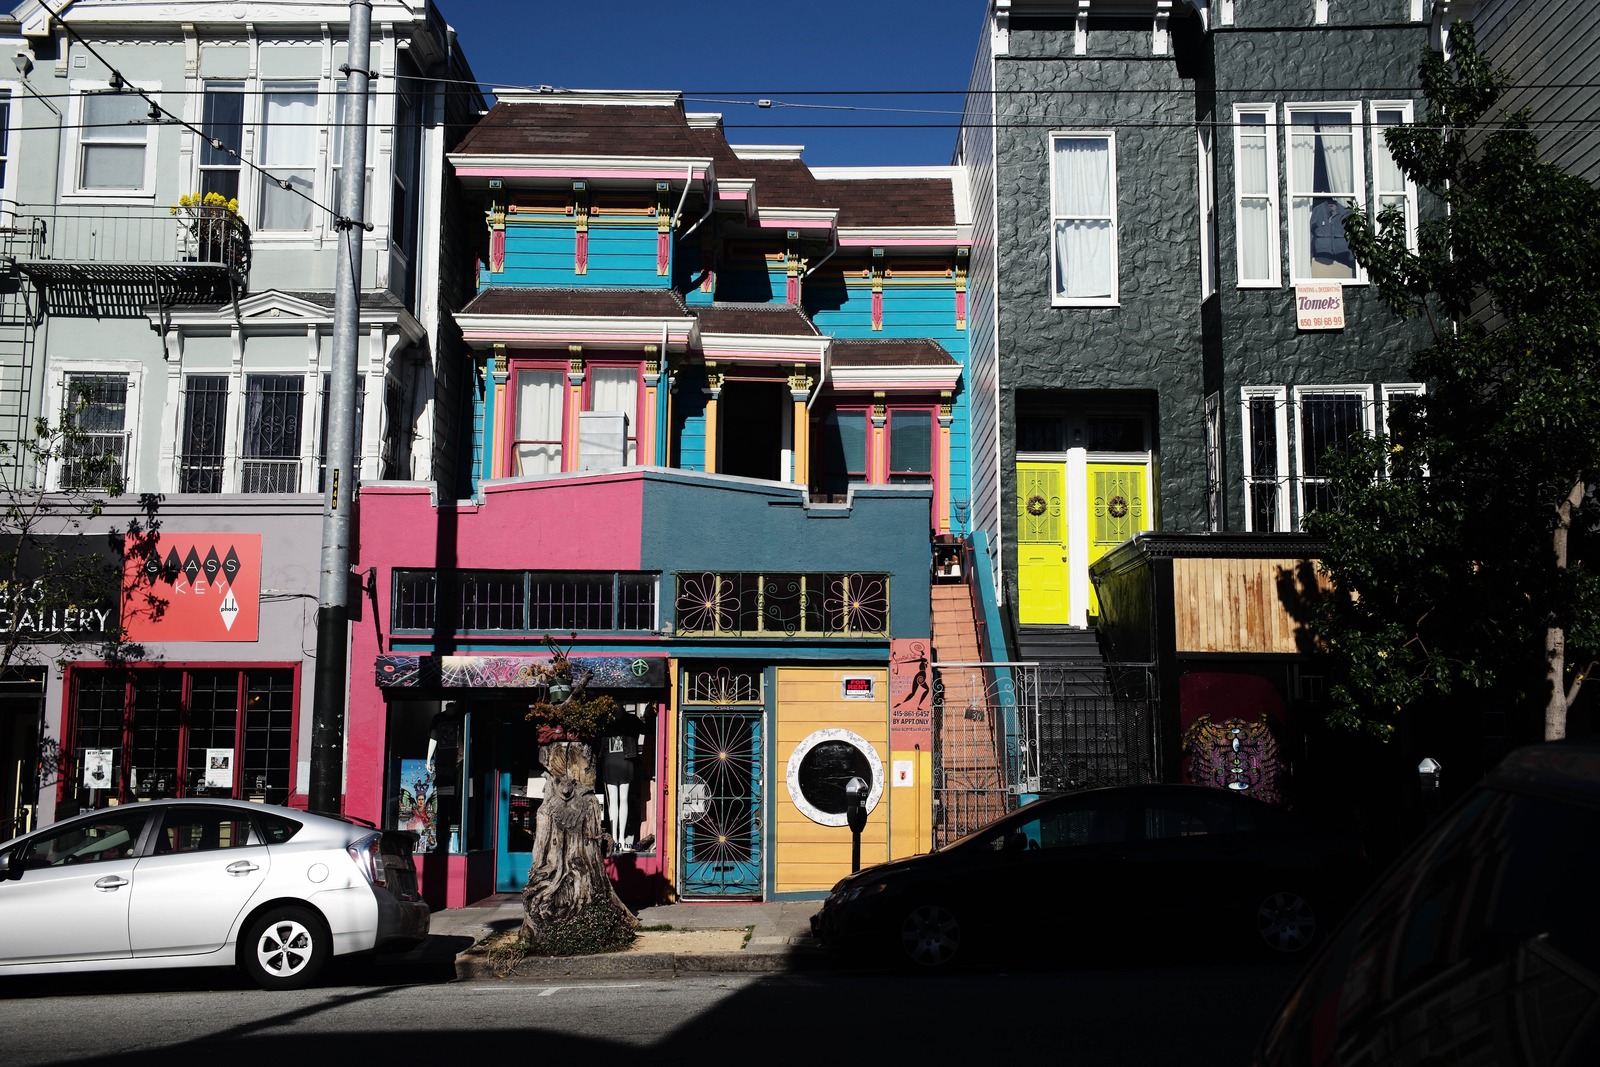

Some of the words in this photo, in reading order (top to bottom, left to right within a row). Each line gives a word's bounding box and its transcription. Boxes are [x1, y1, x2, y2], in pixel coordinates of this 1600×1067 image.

[1298, 296, 1341, 310] Tomek's
[146, 559, 237, 573] GLASS
[175, 580, 226, 595] KEY
[220, 598, 238, 613] photo
[0, 608, 112, 633] GALLERY
